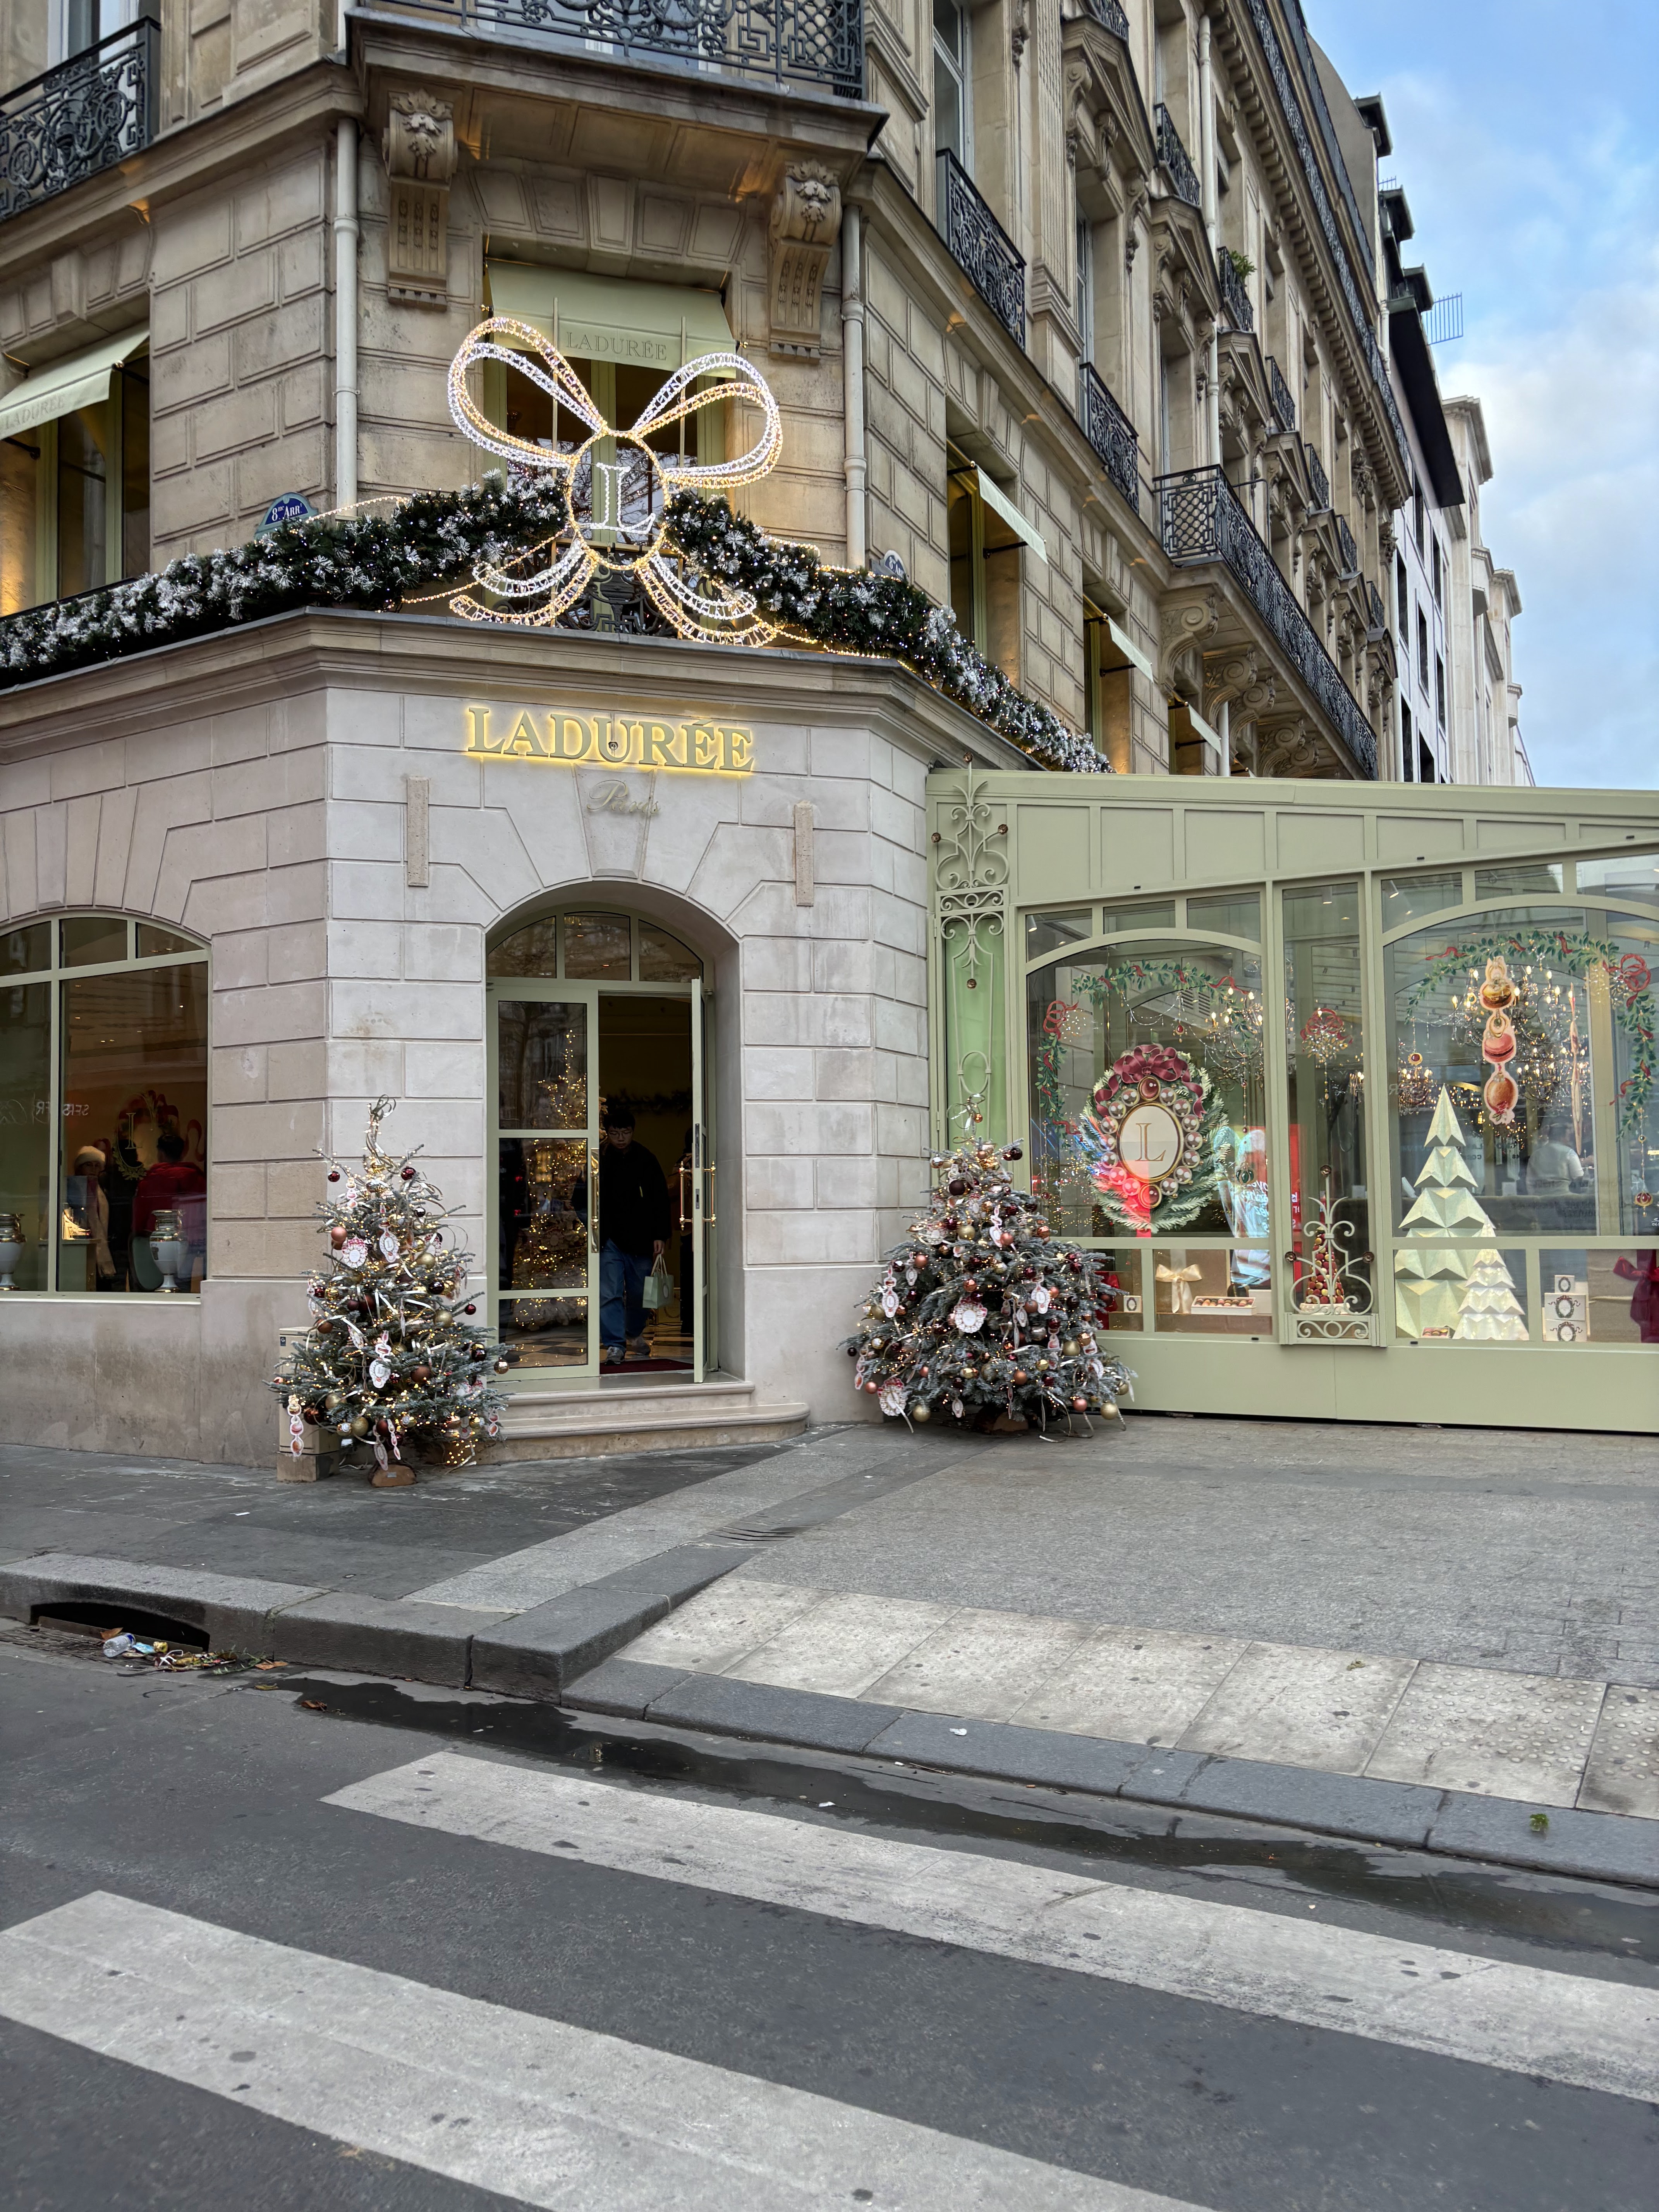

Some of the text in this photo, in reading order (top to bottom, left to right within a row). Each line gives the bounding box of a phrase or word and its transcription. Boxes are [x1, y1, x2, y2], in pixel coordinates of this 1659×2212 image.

[566, 331, 667, 361] LADURÉE
[576, 462, 656, 534] L
[468, 707, 754, 771] LADURÉE
[586, 779, 661, 814] Paris
[1135, 1122, 1166, 1162] L
